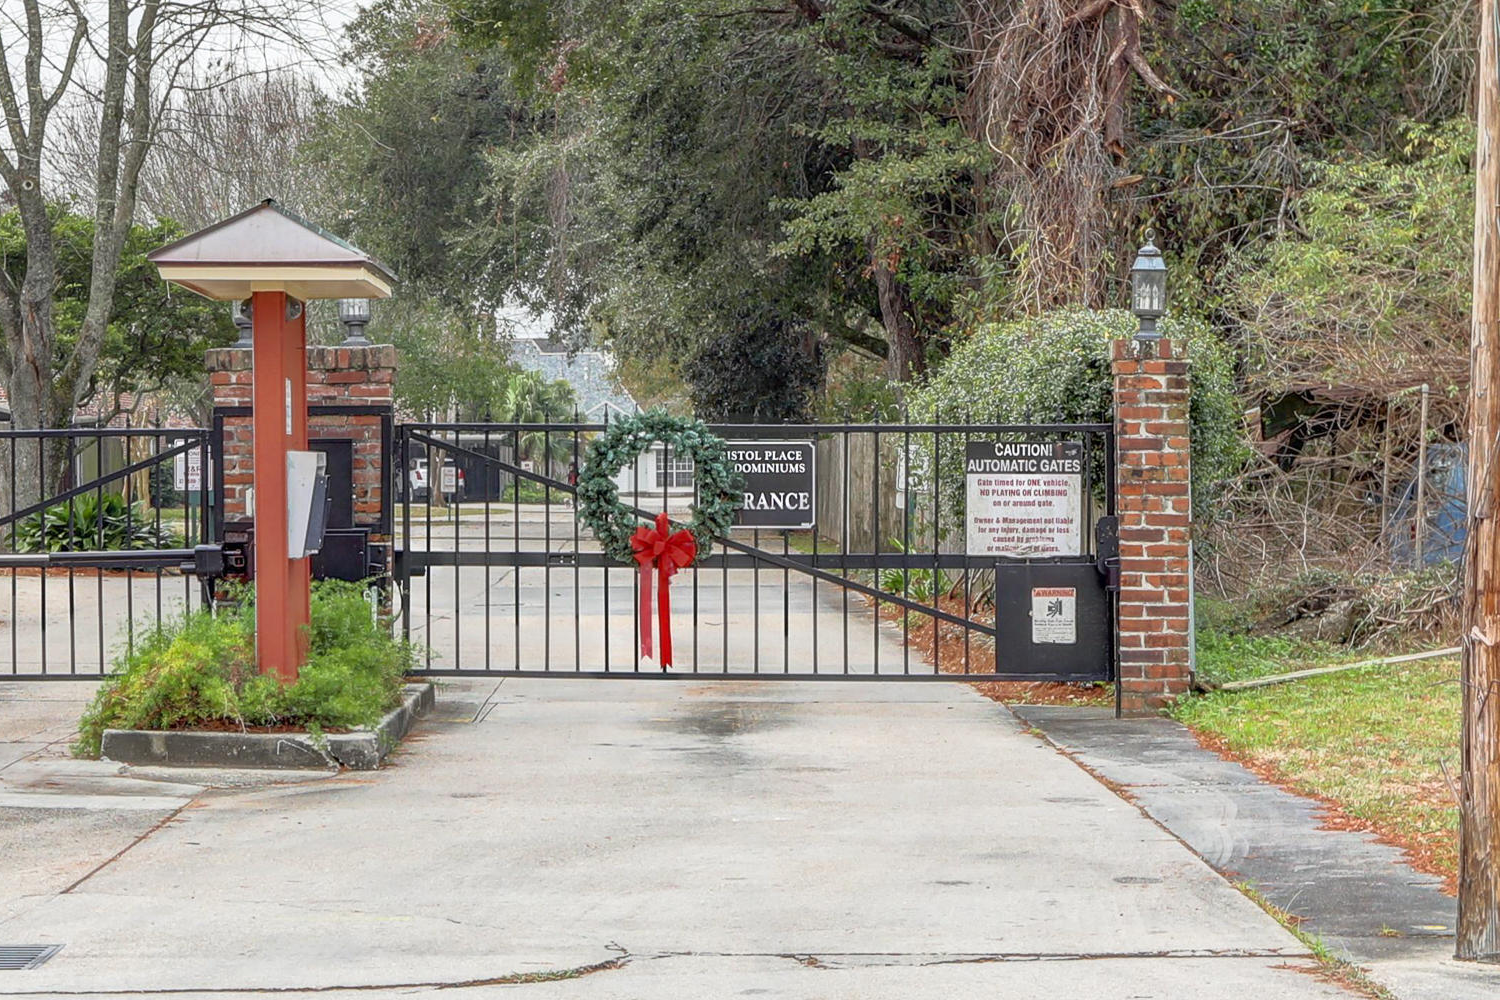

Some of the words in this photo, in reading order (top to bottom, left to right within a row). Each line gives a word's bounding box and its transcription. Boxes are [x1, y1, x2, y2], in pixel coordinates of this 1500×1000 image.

[719, 450, 762, 461] ISTOL
[764, 450, 803, 461] PLACE
[994, 443, 1053, 457] CAUTION!
[734, 463, 806, 474] DOMINIUMS
[967, 459, 1037, 472] AUTOMATIC
[1040, 459, 1081, 472] GATES
[1015, 479, 1025, 487] for
[1027, 479, 1041, 487] ONE
[979, 489, 990, 497] NO
[1022, 489, 1032, 497] OR
[1033, 489, 1068, 497] CLIMBING
[743, 492, 810, 510] RANCE
